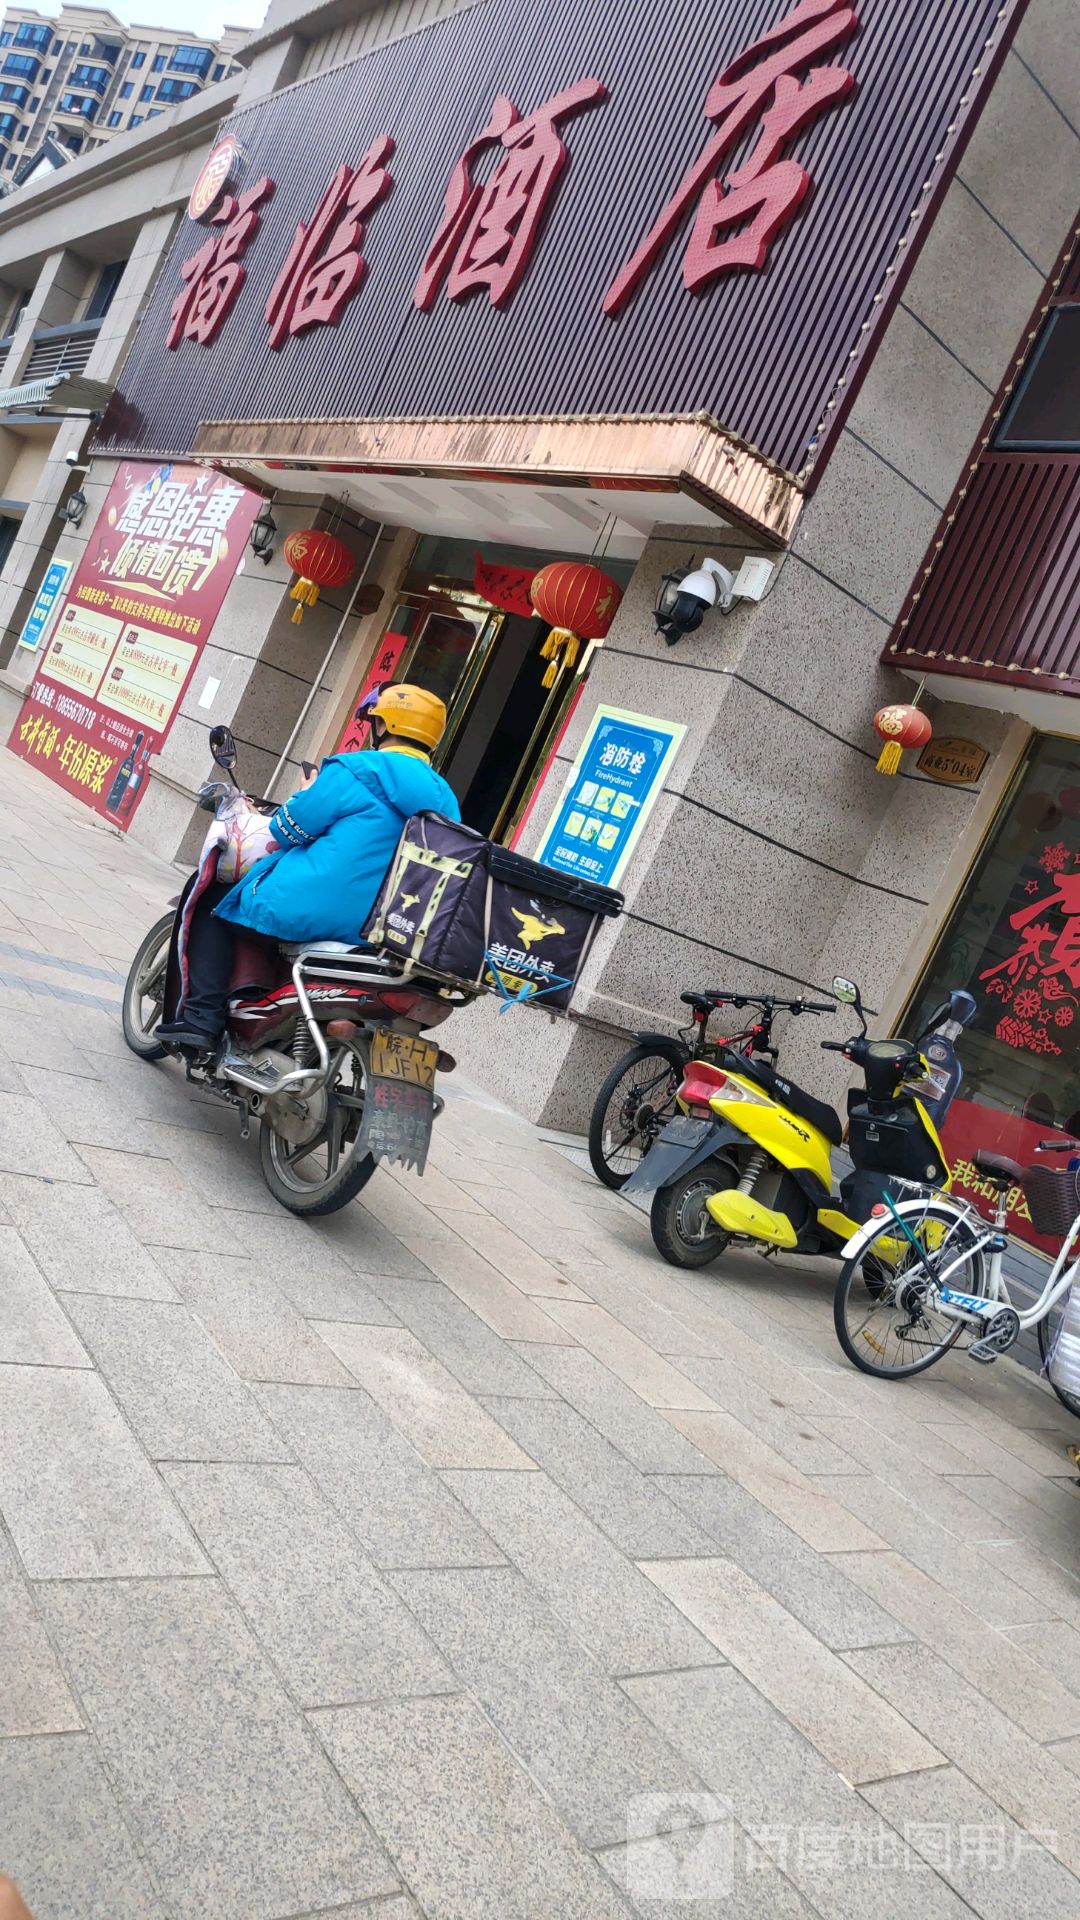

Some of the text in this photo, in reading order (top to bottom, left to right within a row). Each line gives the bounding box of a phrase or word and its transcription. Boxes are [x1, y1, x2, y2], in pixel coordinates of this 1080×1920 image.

[166, 0, 858, 352] 福临酒店
[109, 531, 222, 595] 倾情回馈
[599, 742, 646, 775] 消防栓
[594, 769, 633, 788] FireHydrant
[387, 912, 415, 935] 美团外卖
[484, 942, 556, 983] 美团外卖
